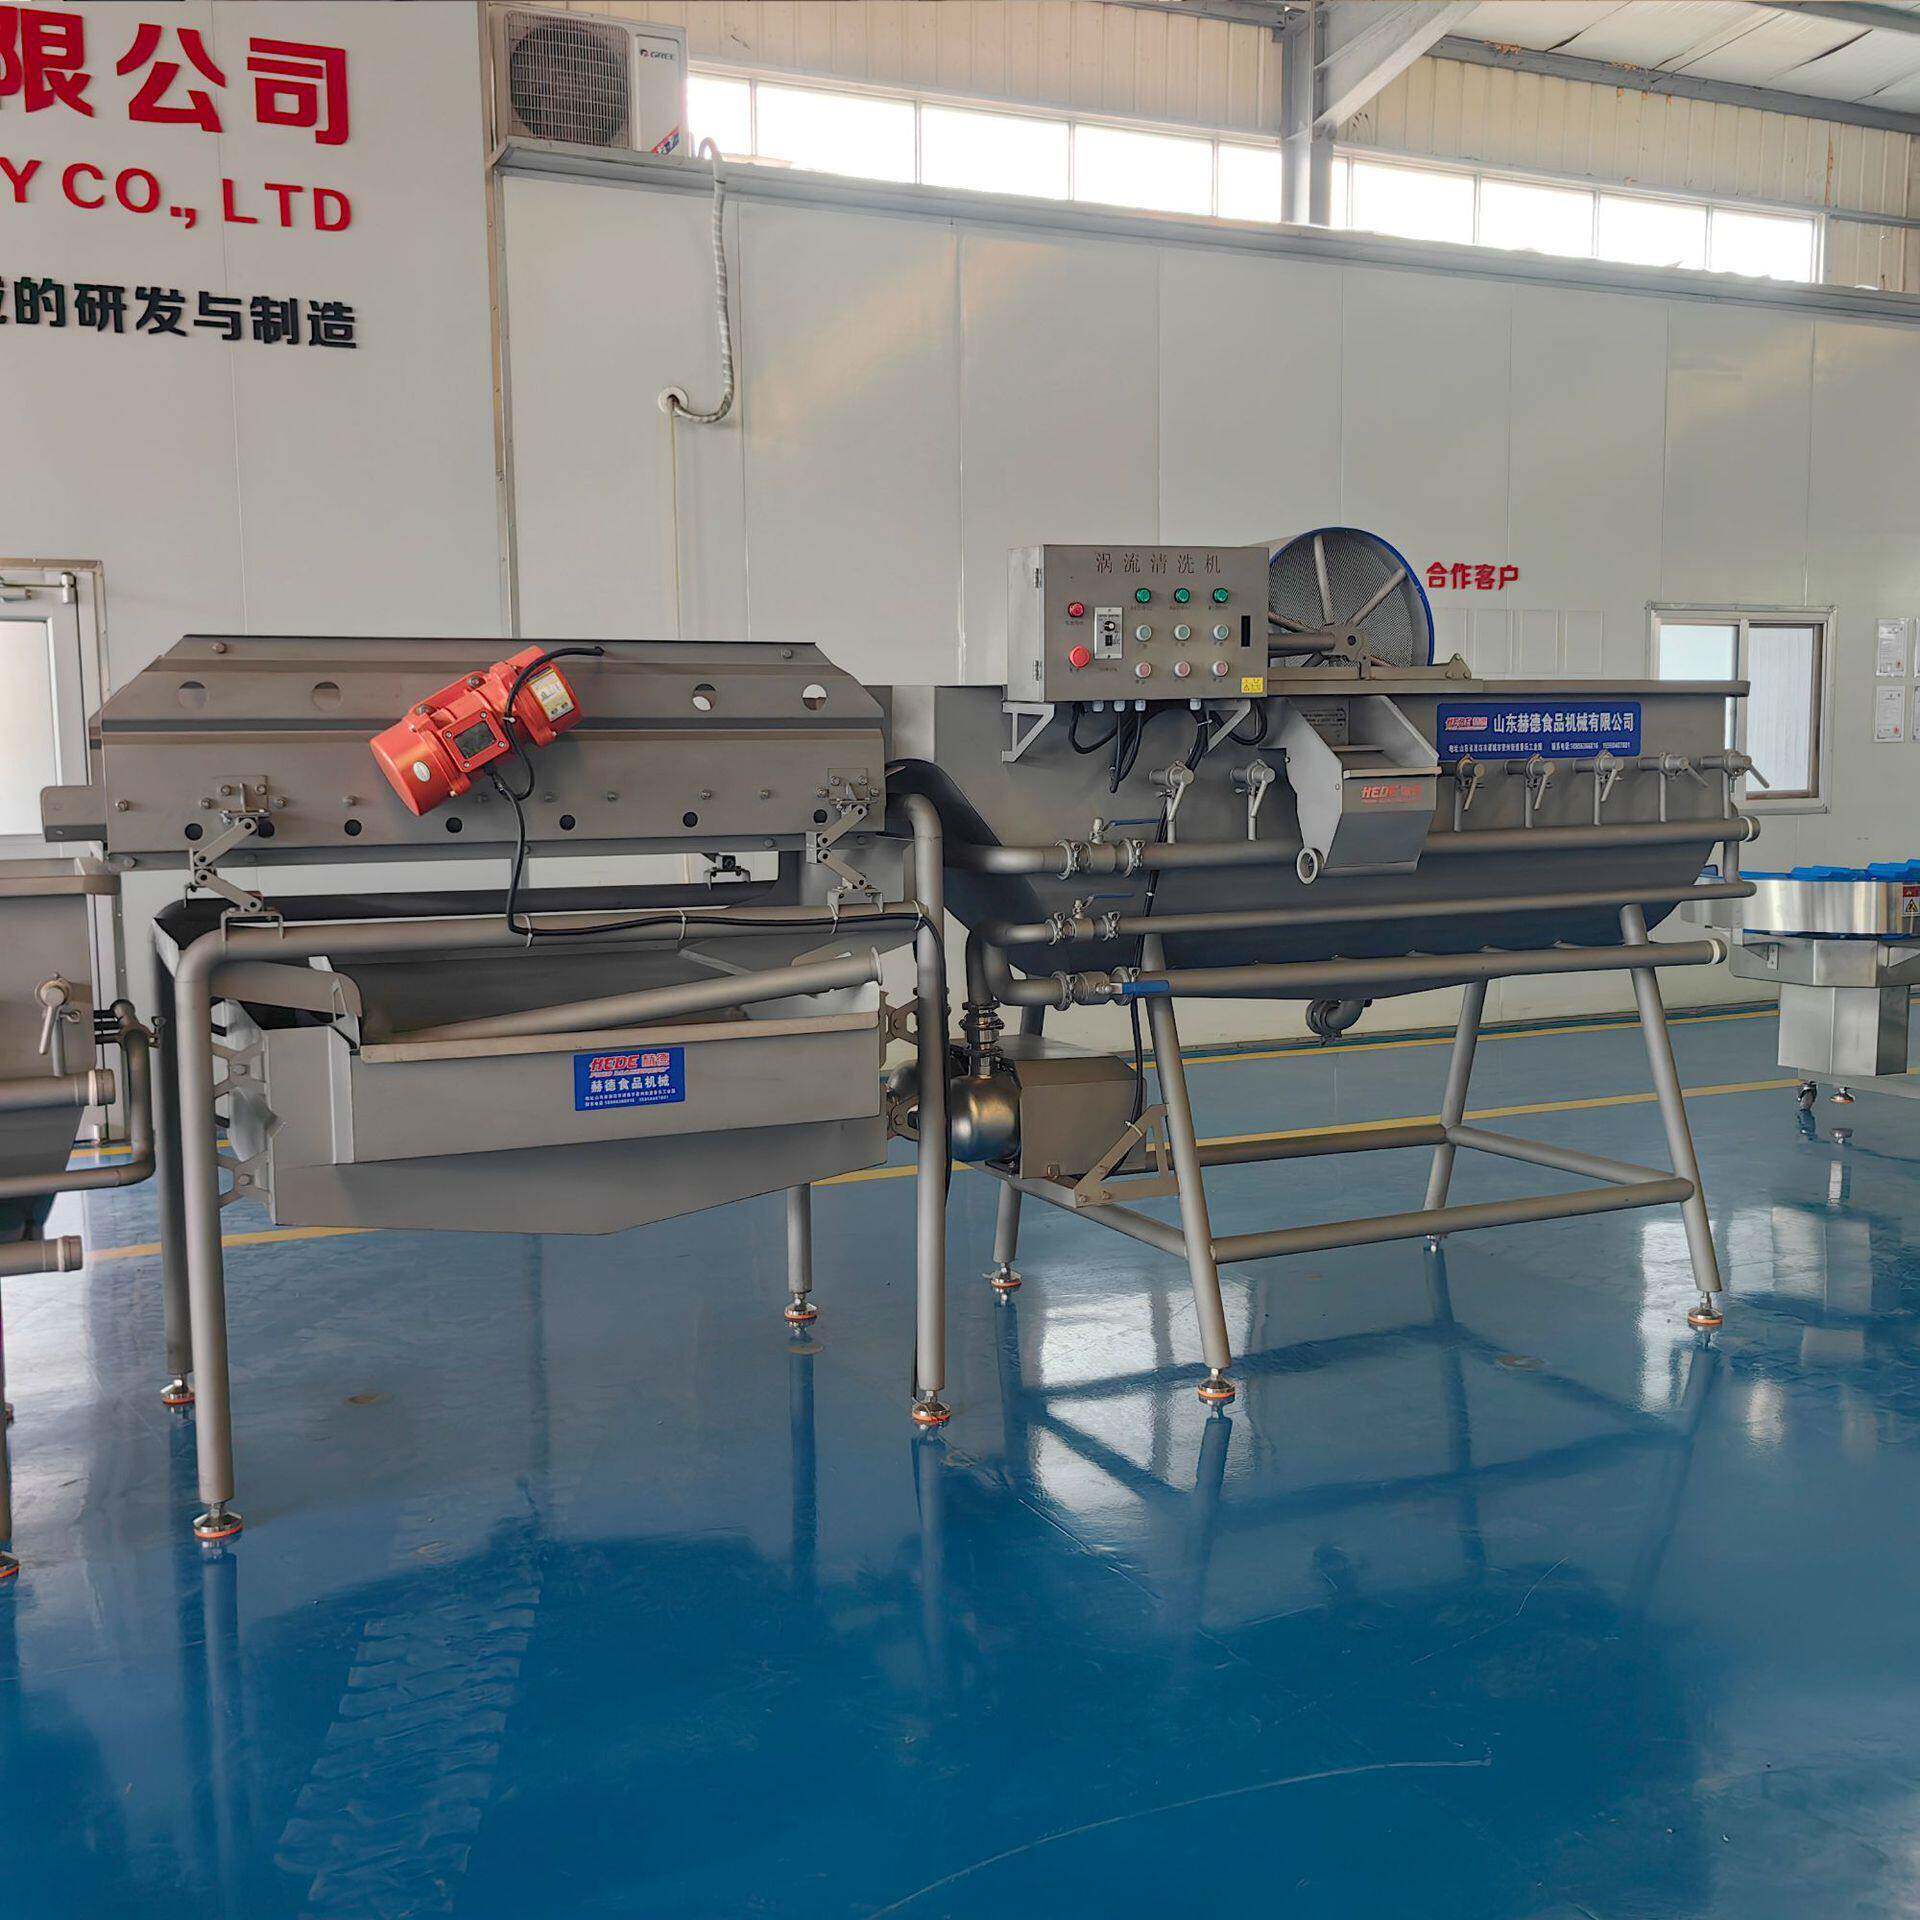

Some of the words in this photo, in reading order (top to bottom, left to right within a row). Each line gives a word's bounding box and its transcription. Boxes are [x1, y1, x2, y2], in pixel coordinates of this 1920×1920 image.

[0, 6, 349, 145] 限公司
[61, 162, 197, 229] CO.,
[222, 178, 352, 232] LTD
[0, 276, 357, 349] 的研发与制造
[1096, 552, 1221, 574] 涡流清洗机
[1426, 562, 1519, 590] 合作客户
[1493, 712, 1634, 734] 山东赫德食品机械有限公司
[589, 1054, 640, 1072] HEDE
[590, 1074, 670, 1093] 赫德食品机械
